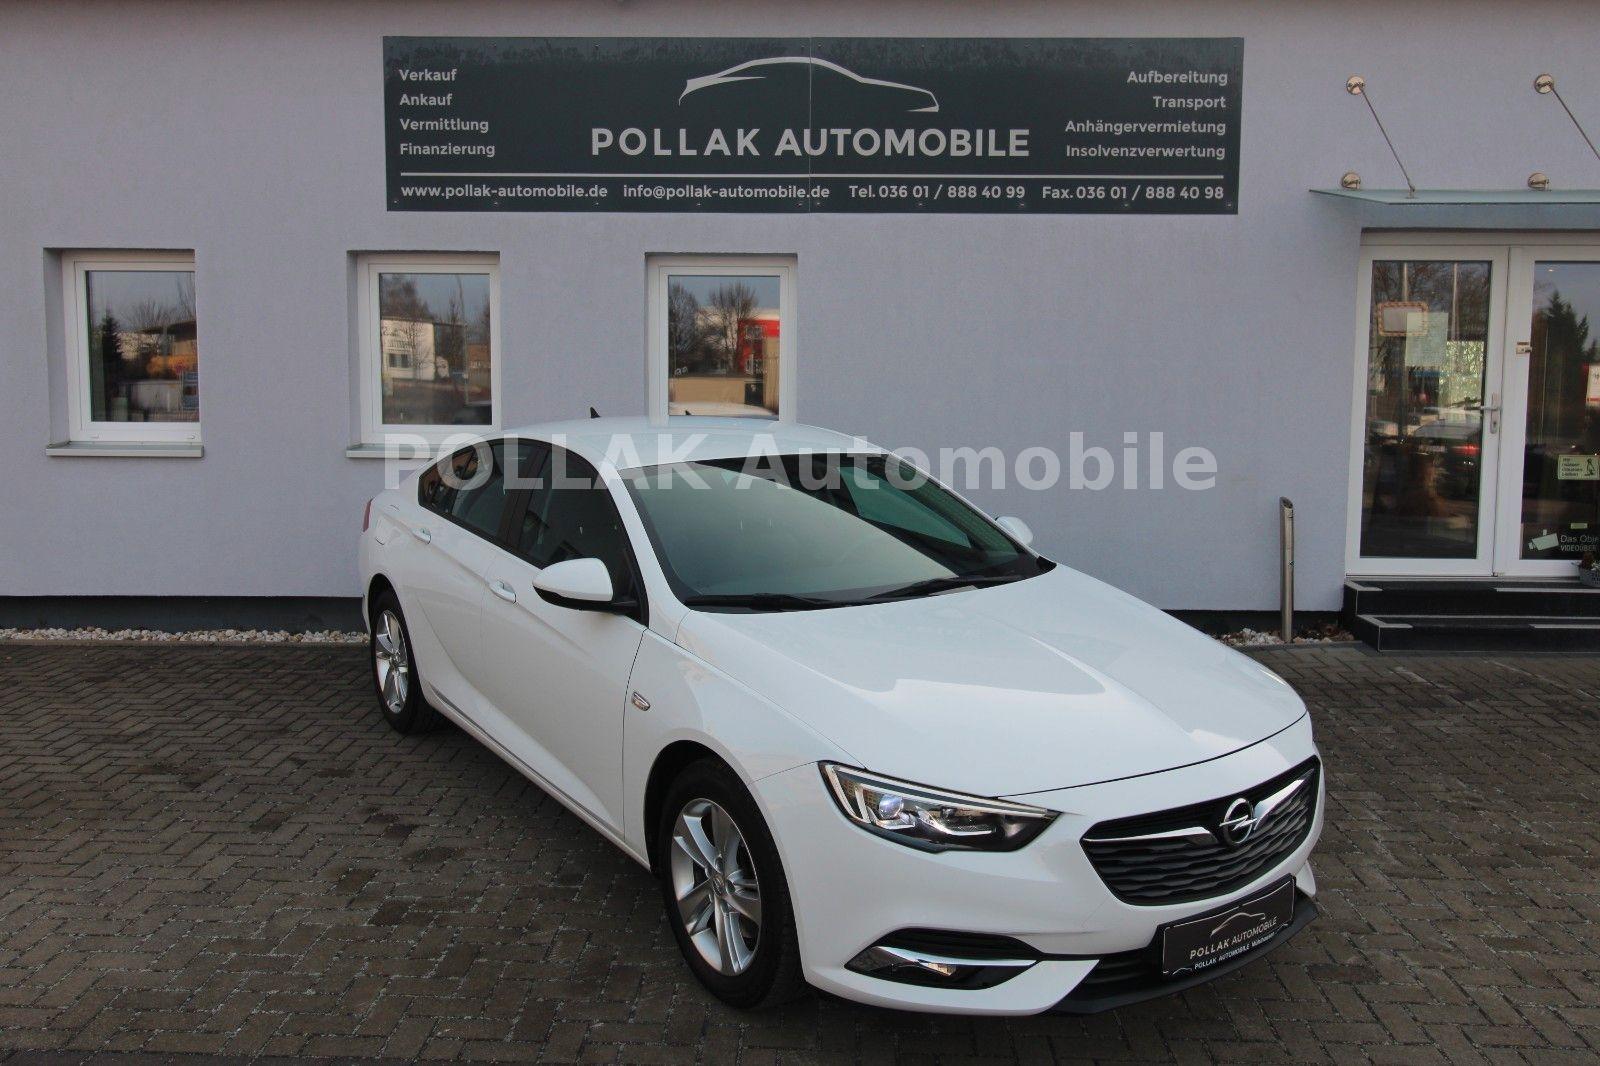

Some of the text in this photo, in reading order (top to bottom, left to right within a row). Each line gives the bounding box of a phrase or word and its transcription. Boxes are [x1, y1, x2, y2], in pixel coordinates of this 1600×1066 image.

[398, 68, 458, 83] Verkauf
[1126, 69, 1229, 86] Aufbereitung
[398, 92, 453, 107] Ankauf
[1152, 94, 1227, 110] Transport
[398, 117, 490, 133] Vermittlung
[1065, 119, 1227, 136] Anhängervermietung
[398, 142, 496, 158] Finanzierung
[590, 127, 1031, 158] POLLAK AUTOMOBILE
[1065, 144, 1226, 161] Insolvenzverwertung
[400, 184, 608, 200] www.pollak-automobile.de
[623, 184, 830, 200] info@pollak-automobile.de
[912, 185, 929, 199] 01
[933, 184, 943, 201] /
[947, 185, 978, 199] 888
[981, 185, 1002, 199] 40
[1005, 185, 1026, 199] 99
[1110, 186, 1127, 199] 01
[1131, 185, 1141, 201] /
[1145, 186, 1176, 200] 888
[1179, 186, 1200, 200] 40
[1204, 186, 1224, 200] 98
[1190, 938, 1230, 960] POLLAK
[1231, 915, 1278, 945] AUTOMOBILE
